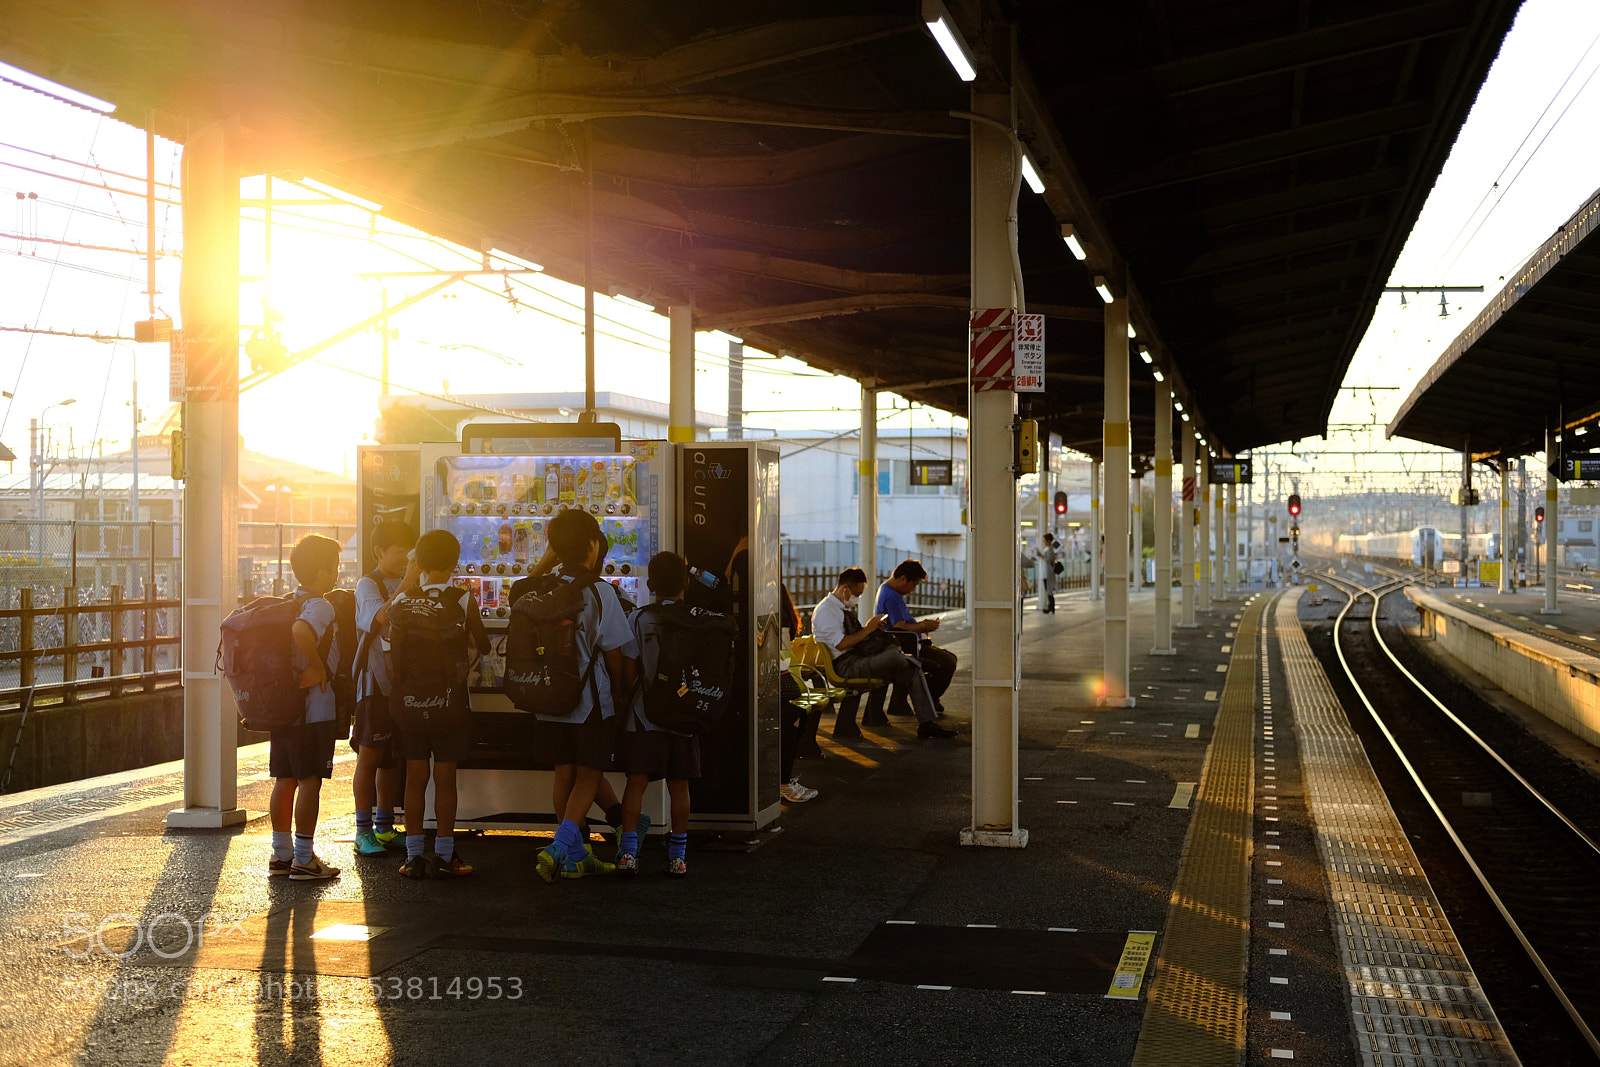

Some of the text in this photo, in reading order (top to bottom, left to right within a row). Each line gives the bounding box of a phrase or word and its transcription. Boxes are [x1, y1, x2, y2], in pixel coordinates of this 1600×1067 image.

[915, 465, 921, 477] 1
[1240, 463, 1249, 476] 2
[1566, 460, 1575, 471] 3
[694, 451, 706, 526] acure
[507, 668, 542, 686] Buddy
[691, 679, 724, 701] Buddy
[403, 695, 445, 709] Buddy
[696, 699, 710, 711] 25
[423, 711, 430, 720] 5
